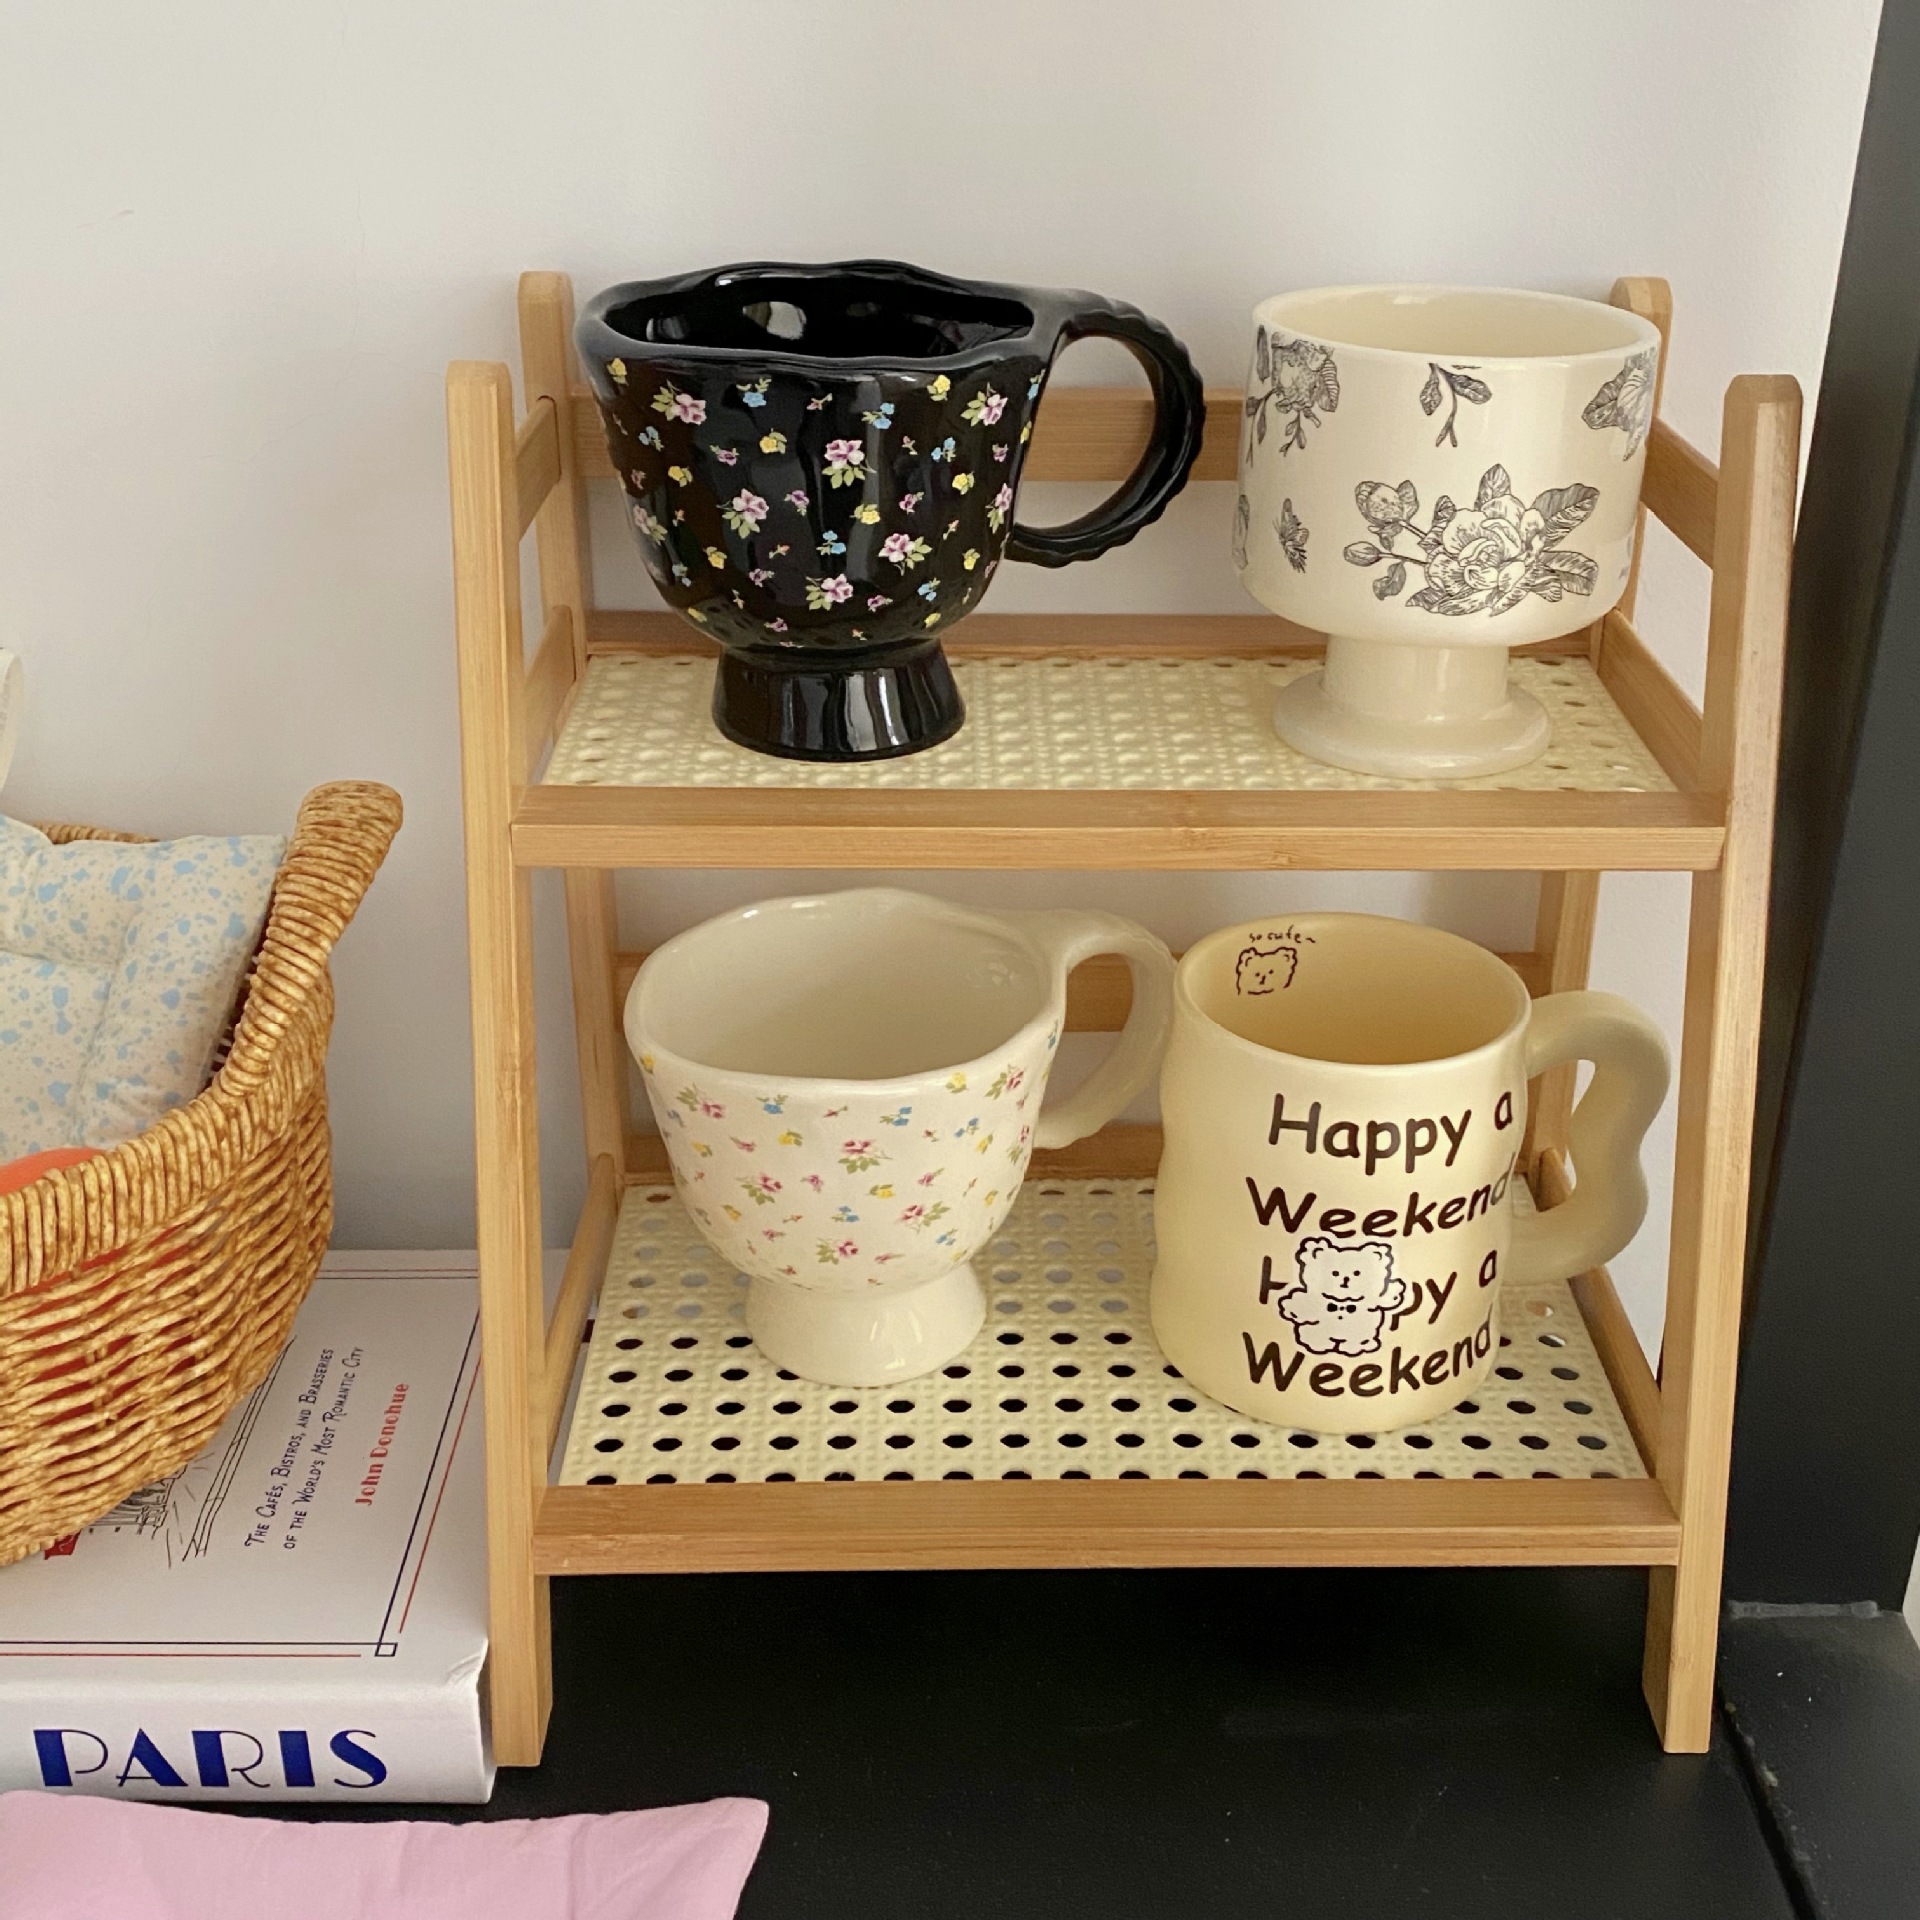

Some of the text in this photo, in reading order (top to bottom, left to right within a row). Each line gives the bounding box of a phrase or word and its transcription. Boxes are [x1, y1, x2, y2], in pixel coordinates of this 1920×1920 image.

[1268, 1091, 1513, 1176] Happy a
[1245, 1152, 1515, 1238] Weekend
[1259, 1250, 1498, 1332] Hpy a
[1242, 1303, 1494, 1397] Weekend
[355, 1383, 410, 1506] John Donohue
[33, 1728, 388, 1789] PARIS
